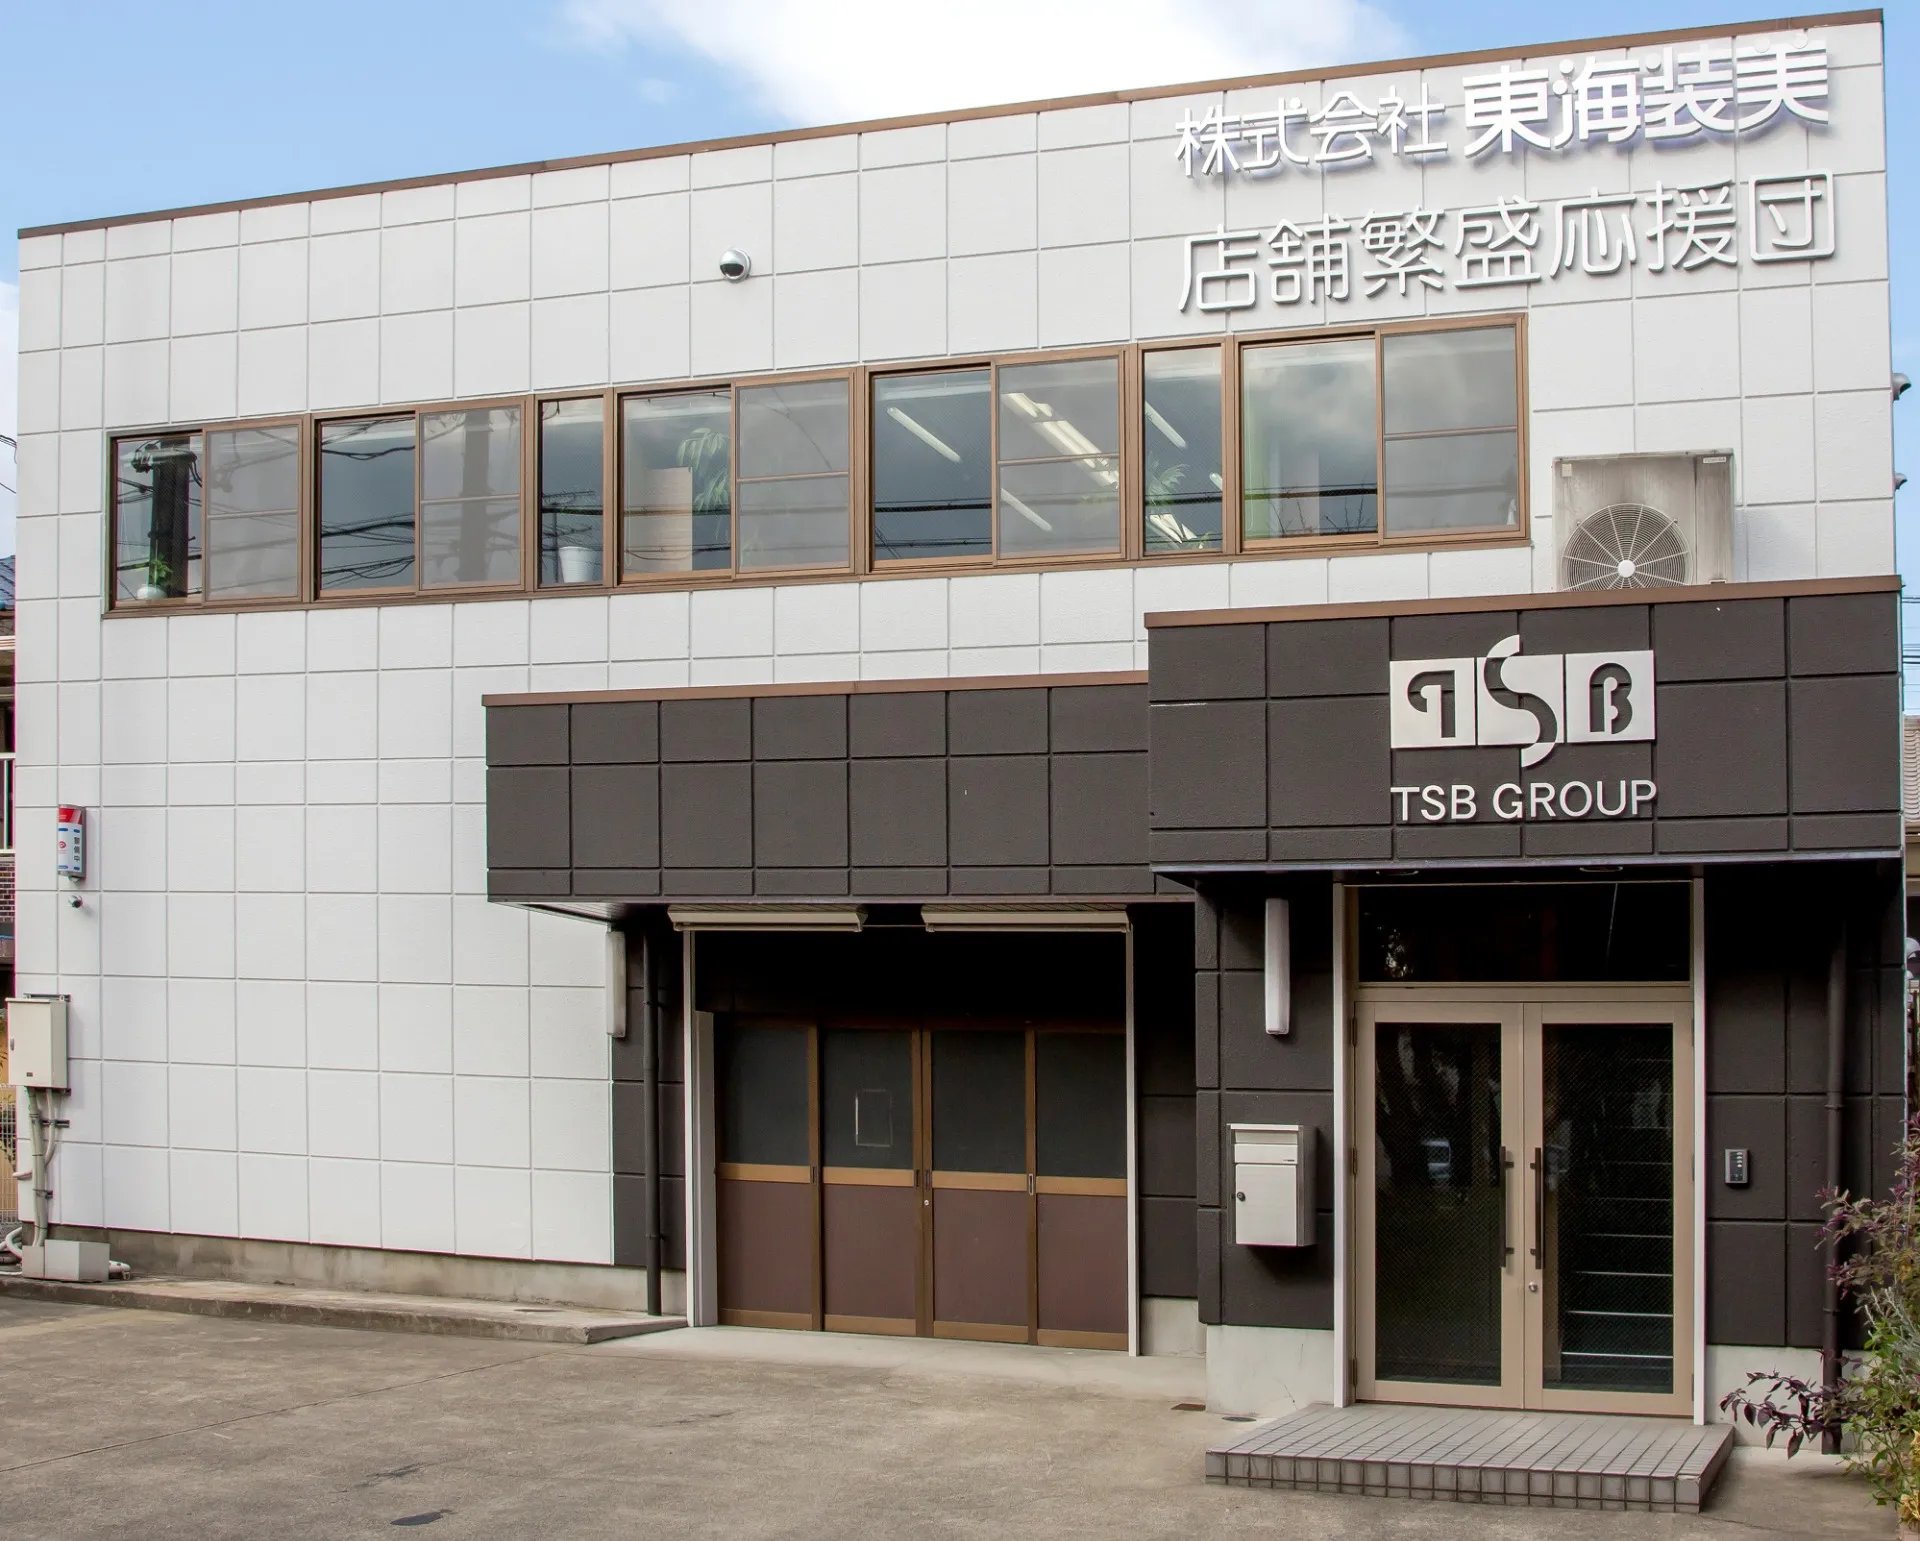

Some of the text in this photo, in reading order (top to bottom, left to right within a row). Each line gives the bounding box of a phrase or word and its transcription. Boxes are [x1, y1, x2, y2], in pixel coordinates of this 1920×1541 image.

[1175, 33, 1829, 177] 株式会社 東海装美
[1178, 168, 1836, 313] 店舗繁盛応援団
[1390, 779, 1658, 822] TSB GROUP
